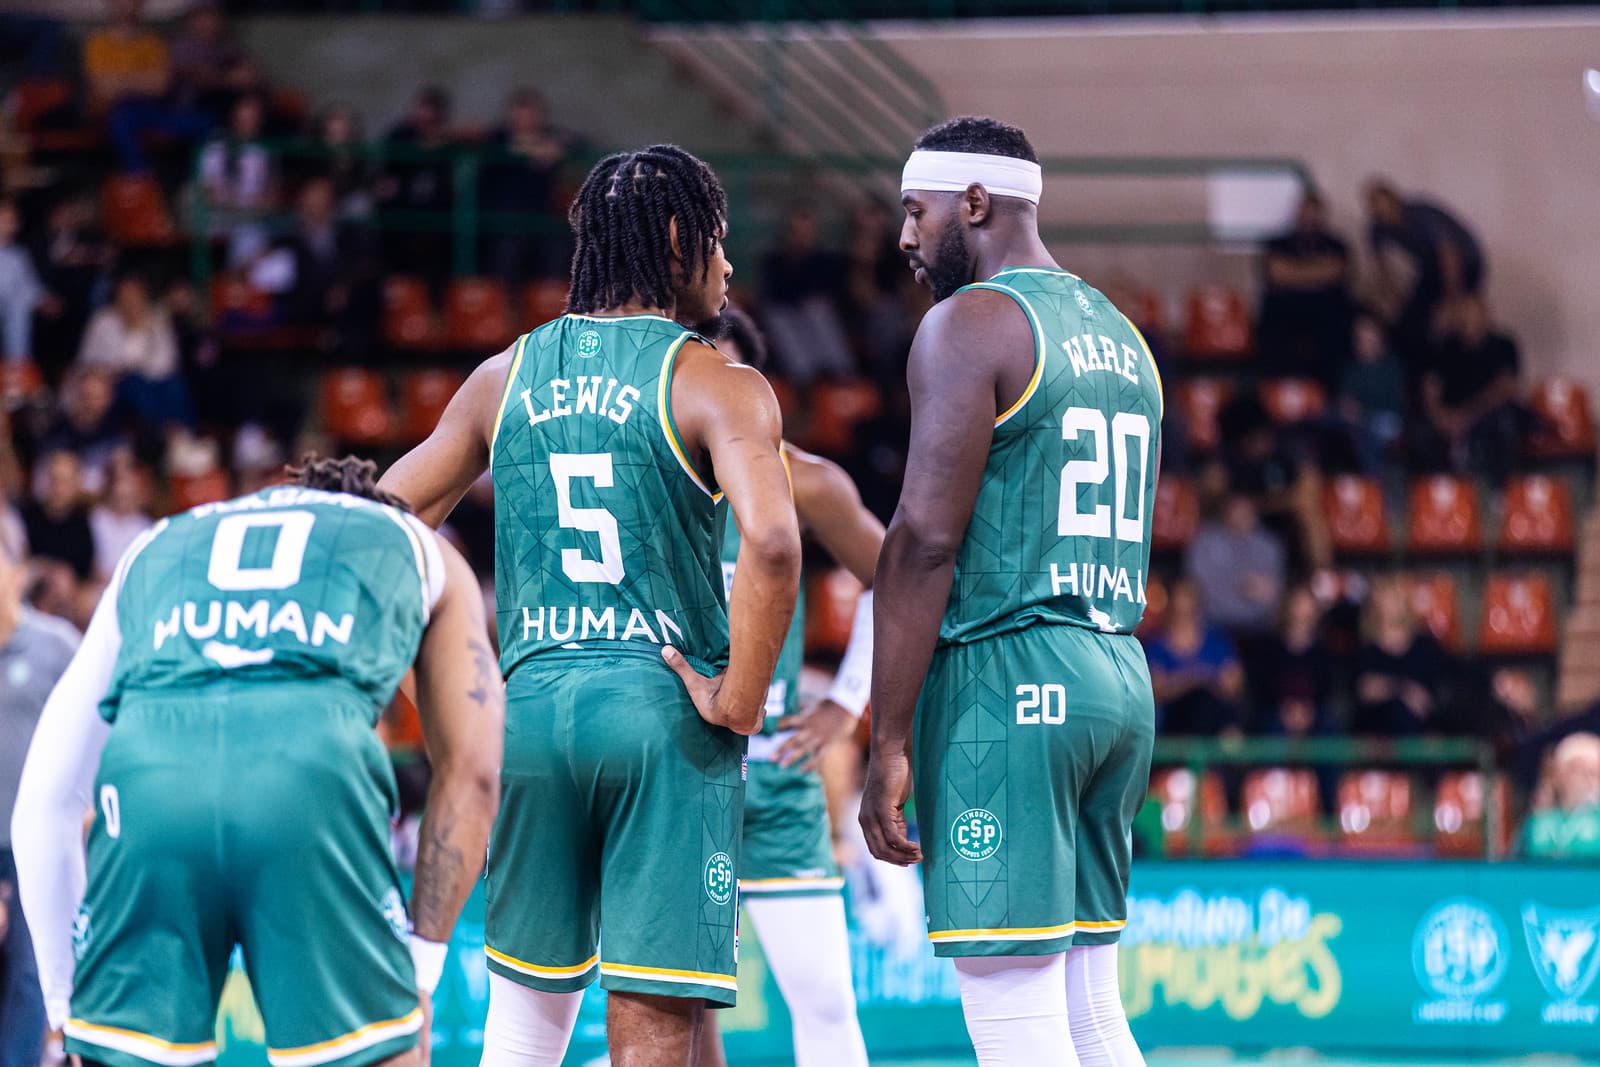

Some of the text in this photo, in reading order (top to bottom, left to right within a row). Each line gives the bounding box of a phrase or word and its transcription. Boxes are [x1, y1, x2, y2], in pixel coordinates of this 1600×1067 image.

[1062, 332, 1139, 386] WARE
[520, 376, 641, 427] LEWIS
[1057, 406, 1151, 544] 20
[549, 452, 626, 585] 5
[207, 510, 316, 591] 0
[153, 600, 354, 651] HUMAN
[1015, 683, 1066, 725] 20
[100, 784, 120, 838] 0
[958, 819, 995, 844] CSP
[709, 863, 730, 888] CSP
